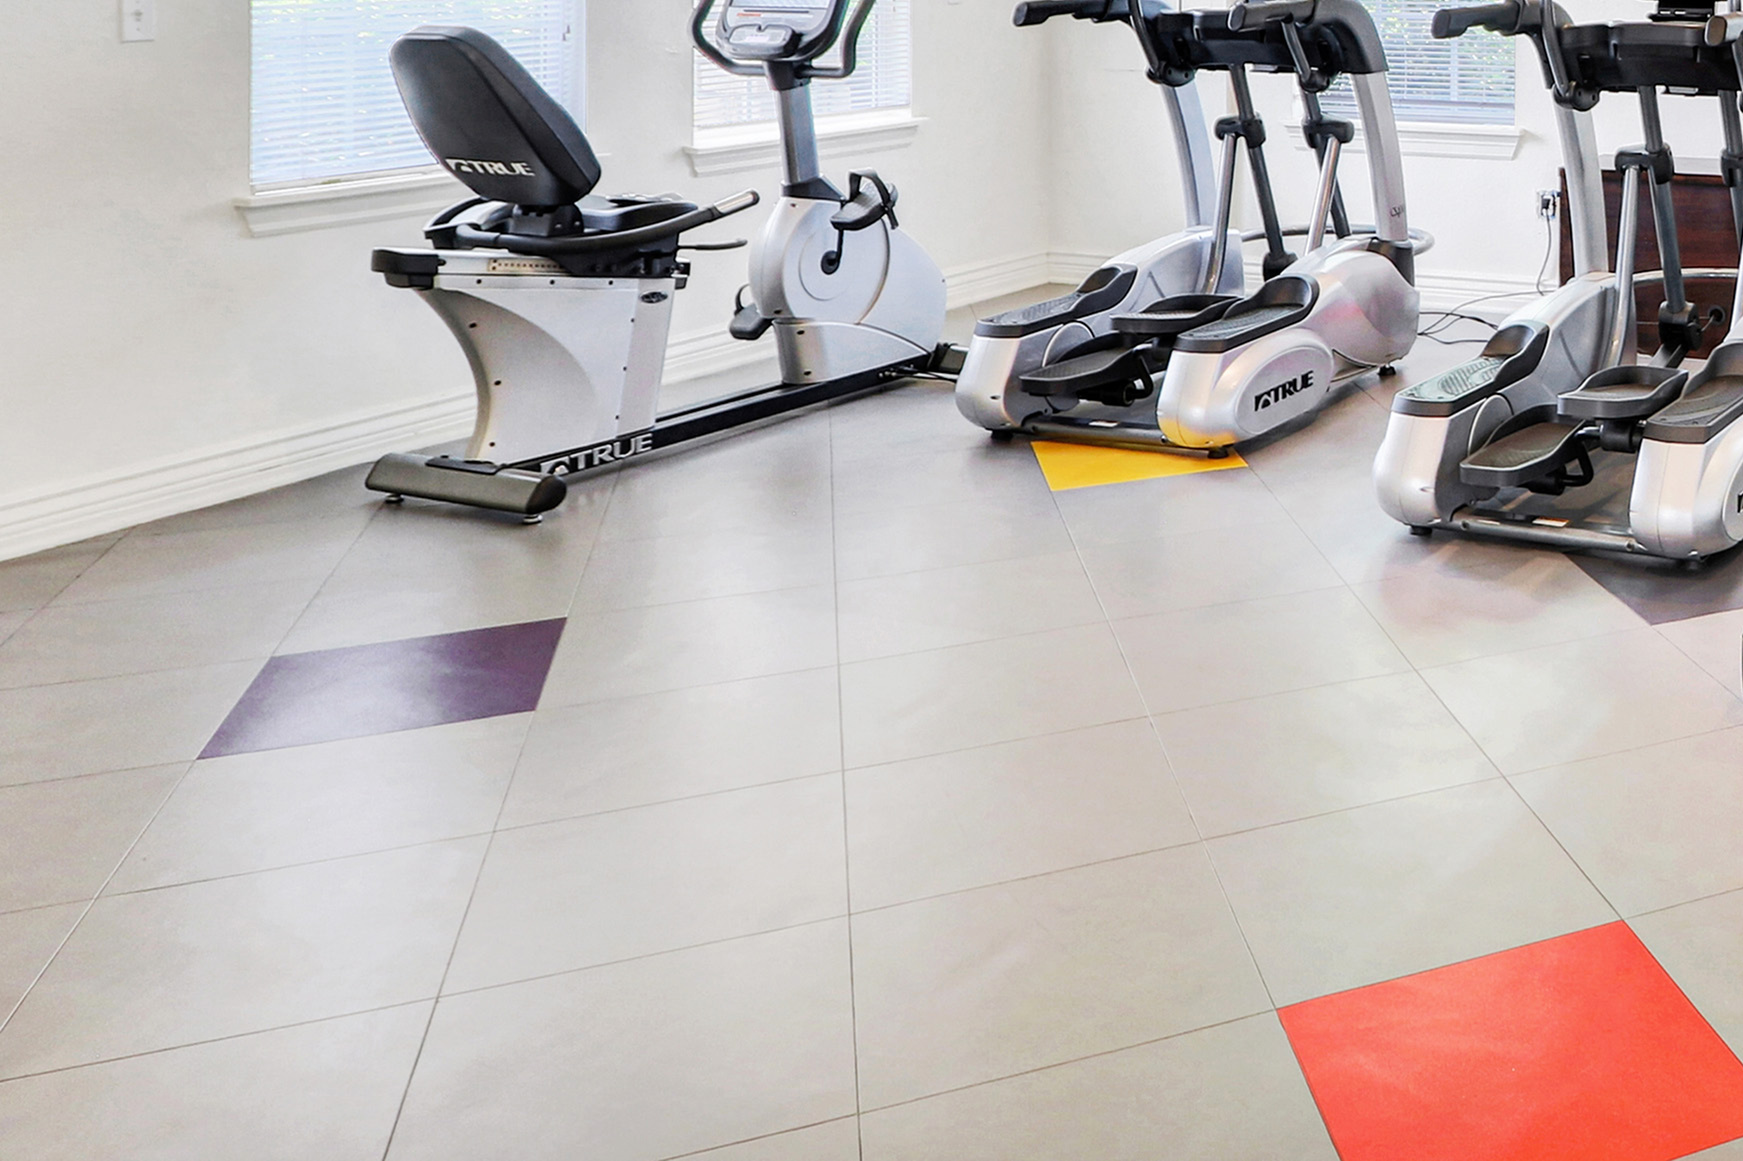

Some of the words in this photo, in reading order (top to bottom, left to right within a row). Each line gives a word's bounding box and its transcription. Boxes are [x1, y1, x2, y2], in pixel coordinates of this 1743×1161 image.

[466, 160, 535, 177] TRUE
[1270, 370, 1315, 404] TRUE
[569, 433, 653, 470] TRUE
